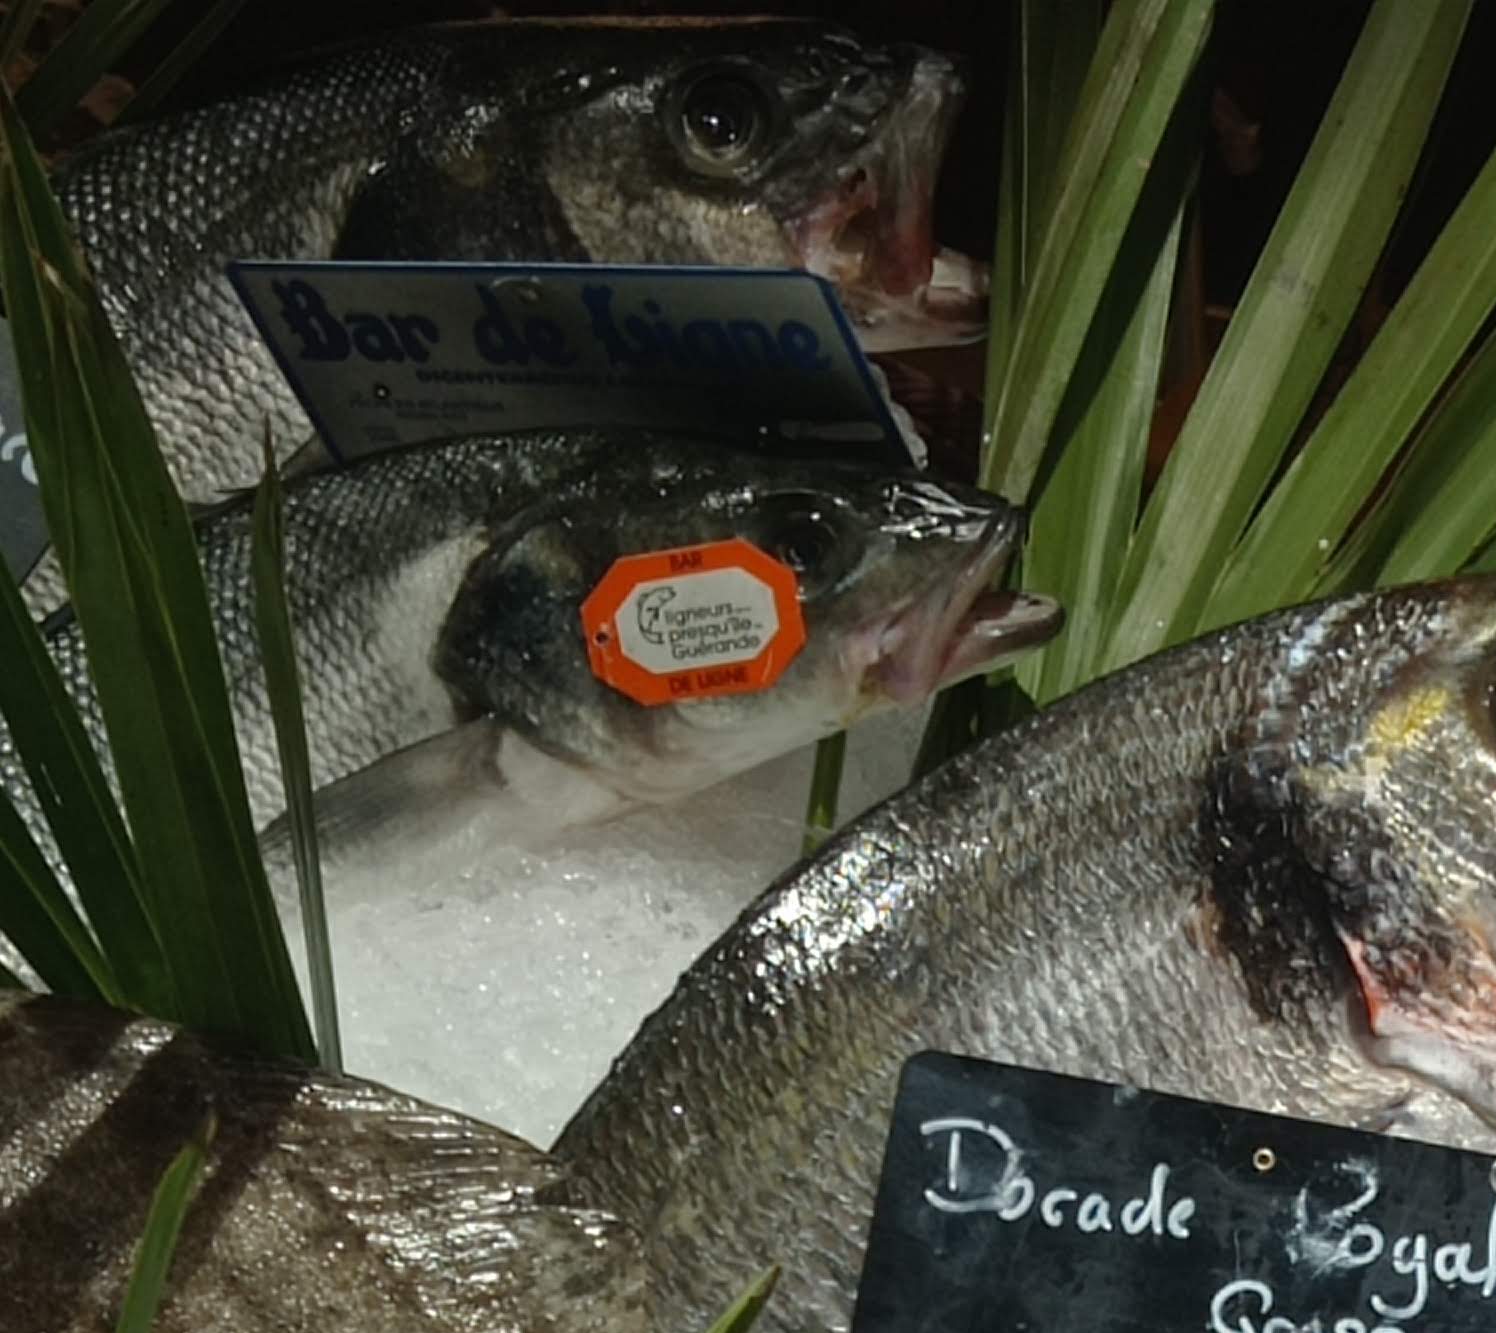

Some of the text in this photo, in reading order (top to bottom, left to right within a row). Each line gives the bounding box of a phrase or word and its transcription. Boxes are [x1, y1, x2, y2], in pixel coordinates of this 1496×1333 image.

[271, 280, 440, 363] Bar
[474, 284, 577, 367] de
[669, 552, 703, 572] BAR
[668, 667, 748, 695] DE LIGNE
[920, 1116, 1197, 1240] Dorade
